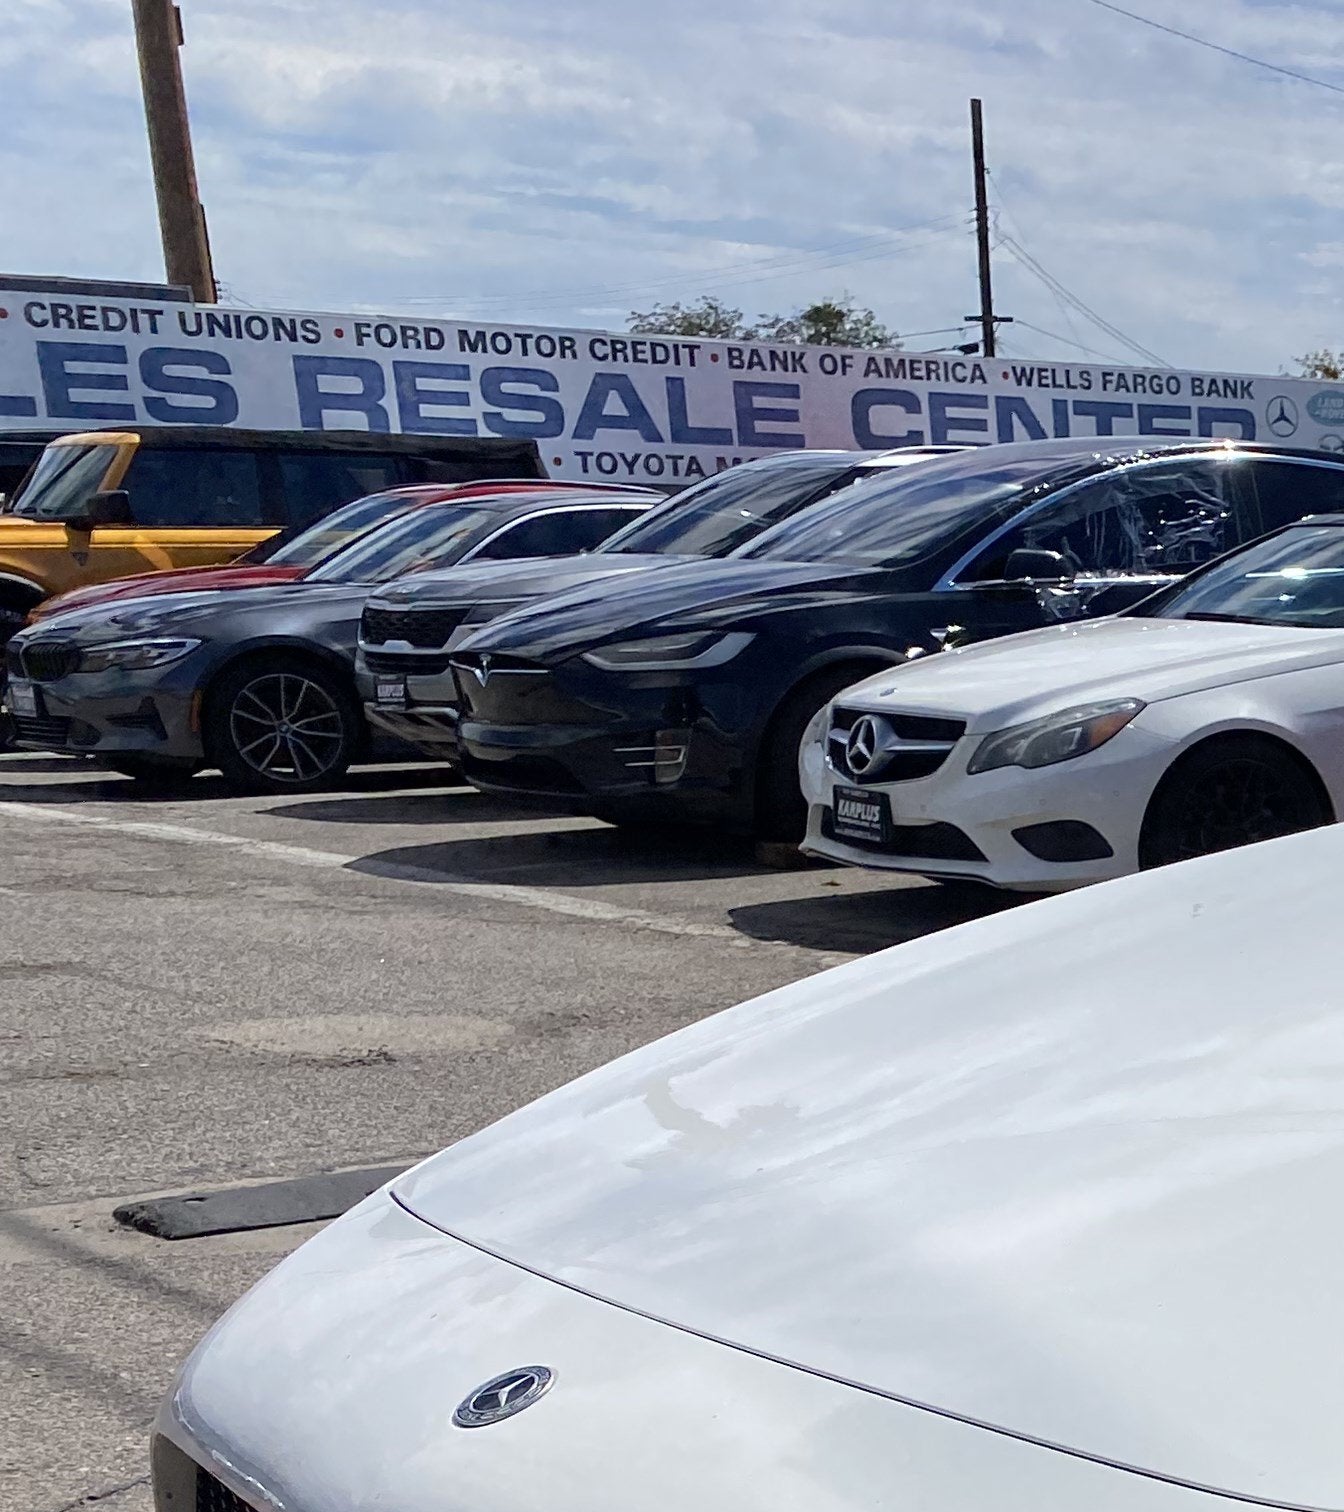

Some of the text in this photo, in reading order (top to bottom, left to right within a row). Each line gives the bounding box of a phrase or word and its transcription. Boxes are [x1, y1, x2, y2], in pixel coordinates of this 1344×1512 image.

[24, 301, 1254, 399] CREDIT UNIONS FORD MOTOR CREDIT BANK OF AMERICA WELLS FARGO BANK
[292, 354, 805, 448] RESALE
[851, 387, 1257, 450] CENTER
[574, 451, 707, 477] TOYOTA
